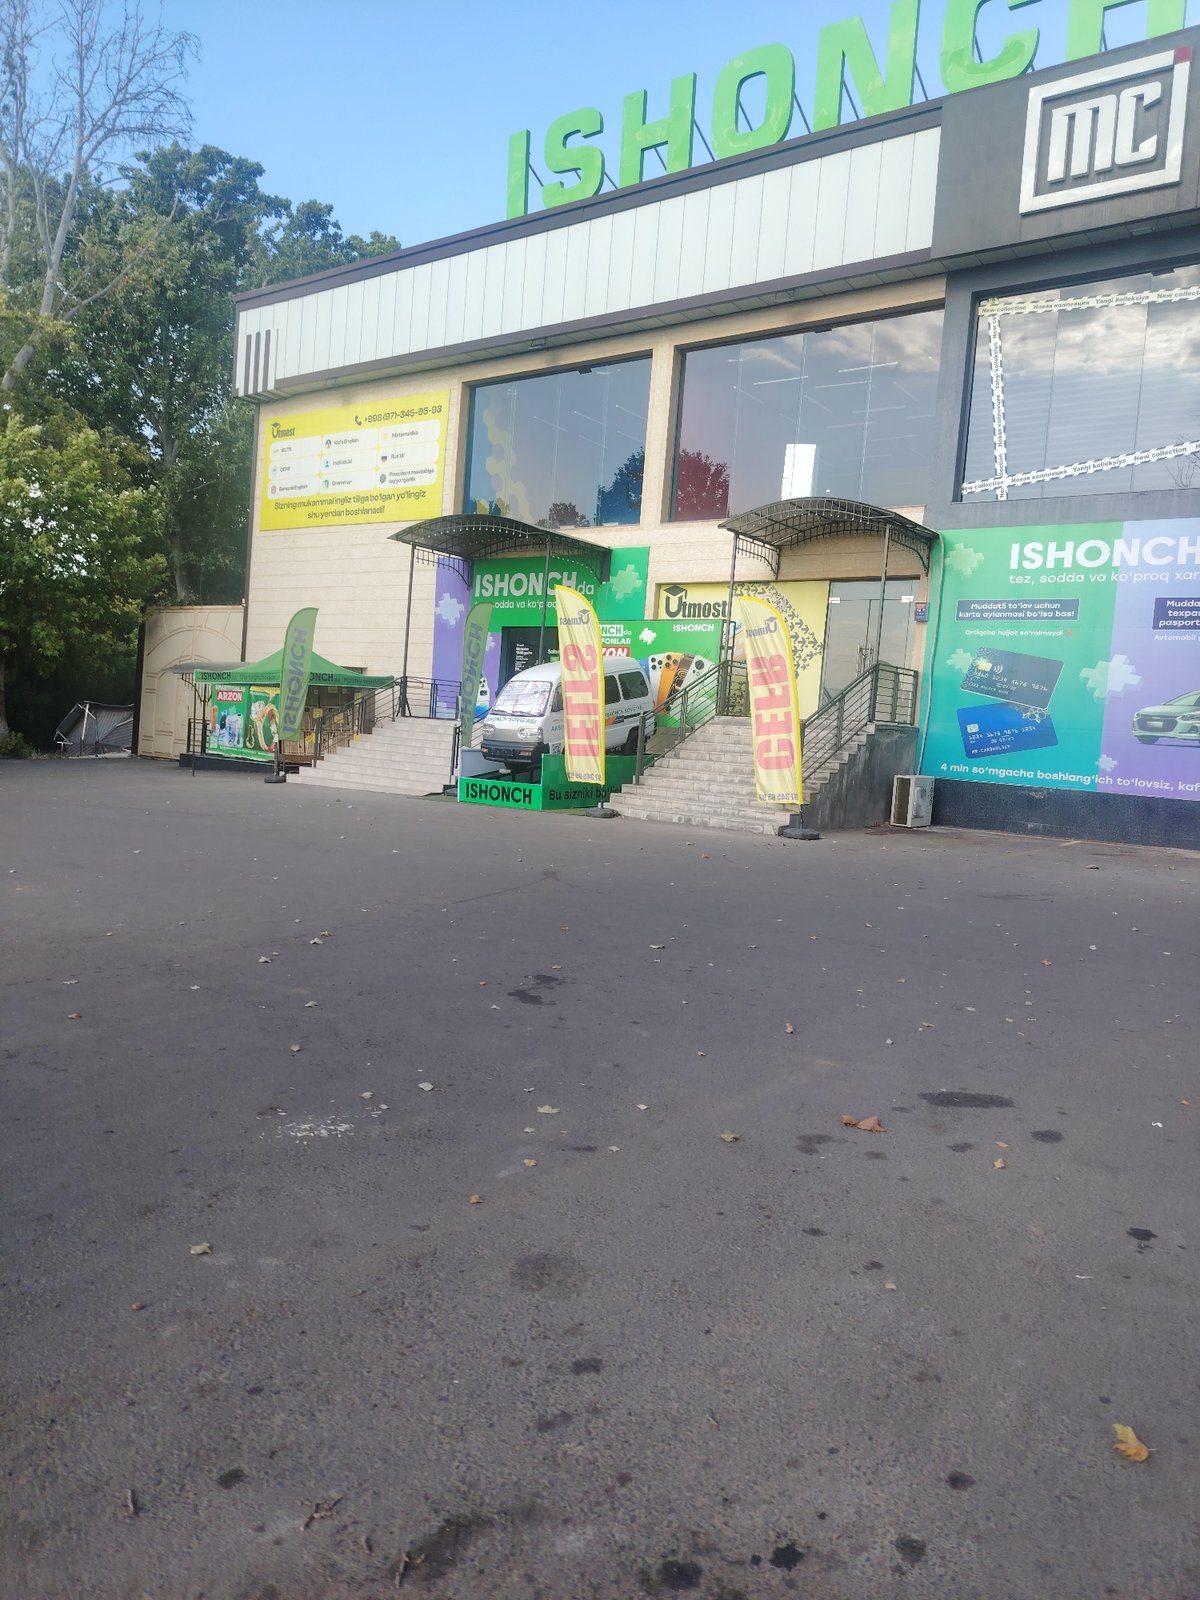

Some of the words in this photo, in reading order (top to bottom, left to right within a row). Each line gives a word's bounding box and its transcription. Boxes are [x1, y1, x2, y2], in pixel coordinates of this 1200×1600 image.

[307, 510, 320, 519] shu
[1009, 574, 1035, 585] tez,
[1040, 572, 1085, 583] sodda
[1088, 574, 1106, 582] va
[494, 600, 514, 609] odda
[664, 590, 728, 618] Utmost
[971, 602, 1007, 610] Muddatli
[982, 610, 1025, 619] aylanmasi
[673, 623, 715, 632] ISHONCH
[201, 671, 231, 680] ISHONCH
[217, 691, 242, 701] ARZON
[940, 763, 948, 771] 4
[950, 764, 969, 773] mln
[465, 782, 532, 805] ISHONCH
[550, 789, 562, 800] Bu
[564, 786, 593, 800] sizniki
